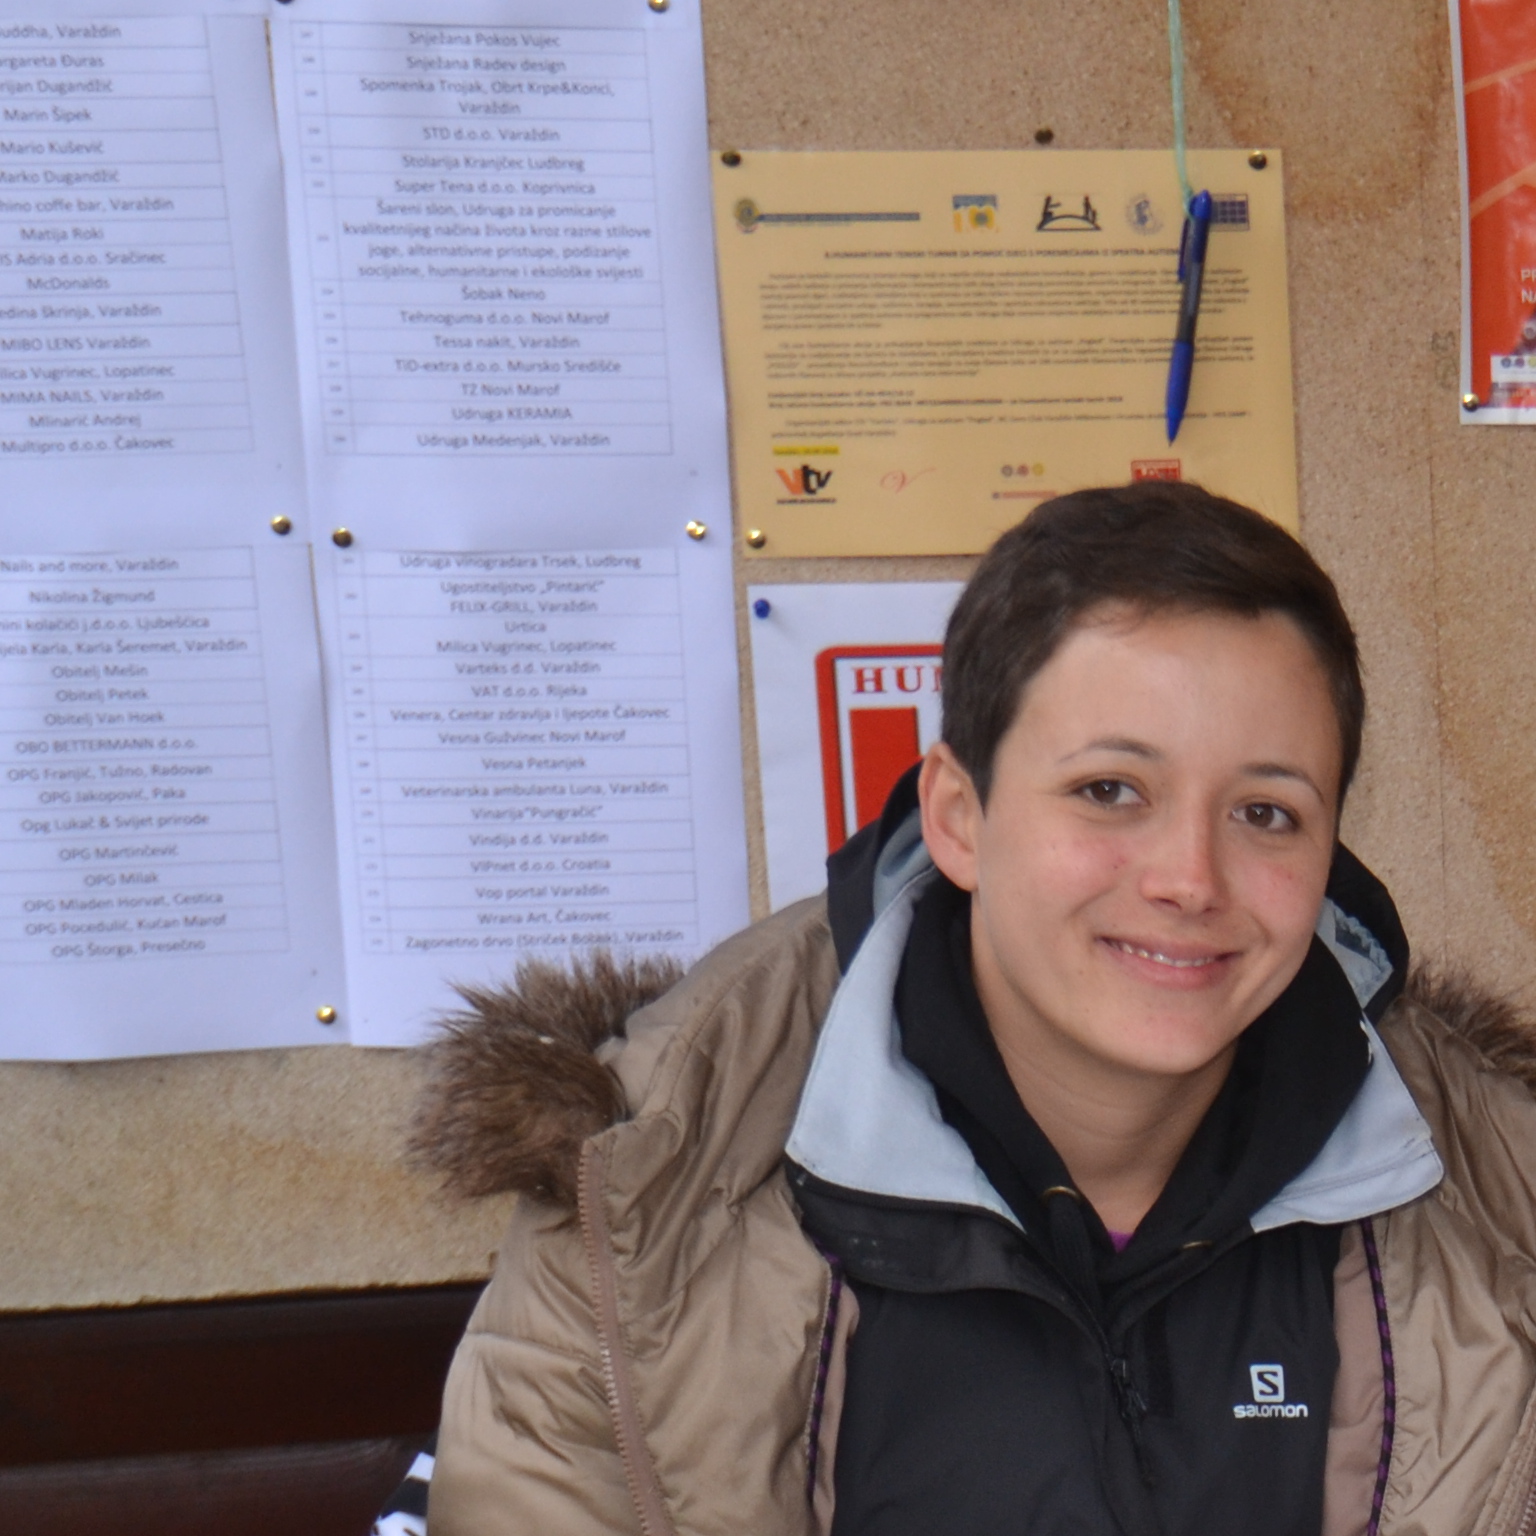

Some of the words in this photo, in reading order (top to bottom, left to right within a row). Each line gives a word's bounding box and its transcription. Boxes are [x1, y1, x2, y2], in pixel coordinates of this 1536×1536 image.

[498, 128, 559, 141] Varaždin
[395, 179, 435, 193] Super
[463, 204, 514, 218] Udruga
[519, 206, 533, 215] za
[538, 205, 615, 219] promicanje
[87, 336, 149, 349] Varaždin
[482, 384, 513, 395] Novi
[452, 408, 502, 421] Udruga
[29, 591, 88, 603] Nikolina
[52, 665, 100, 679] Obitelj
[56, 689, 104, 702] Obitelj
[546, 684, 586, 699] Rijeka
[52, 739, 153, 752] BETTERMANN
[482, 759, 523, 769] Vesna
[550, 832, 607, 844] Varaždin
[1233, 1404, 1309, 1419] salomon
